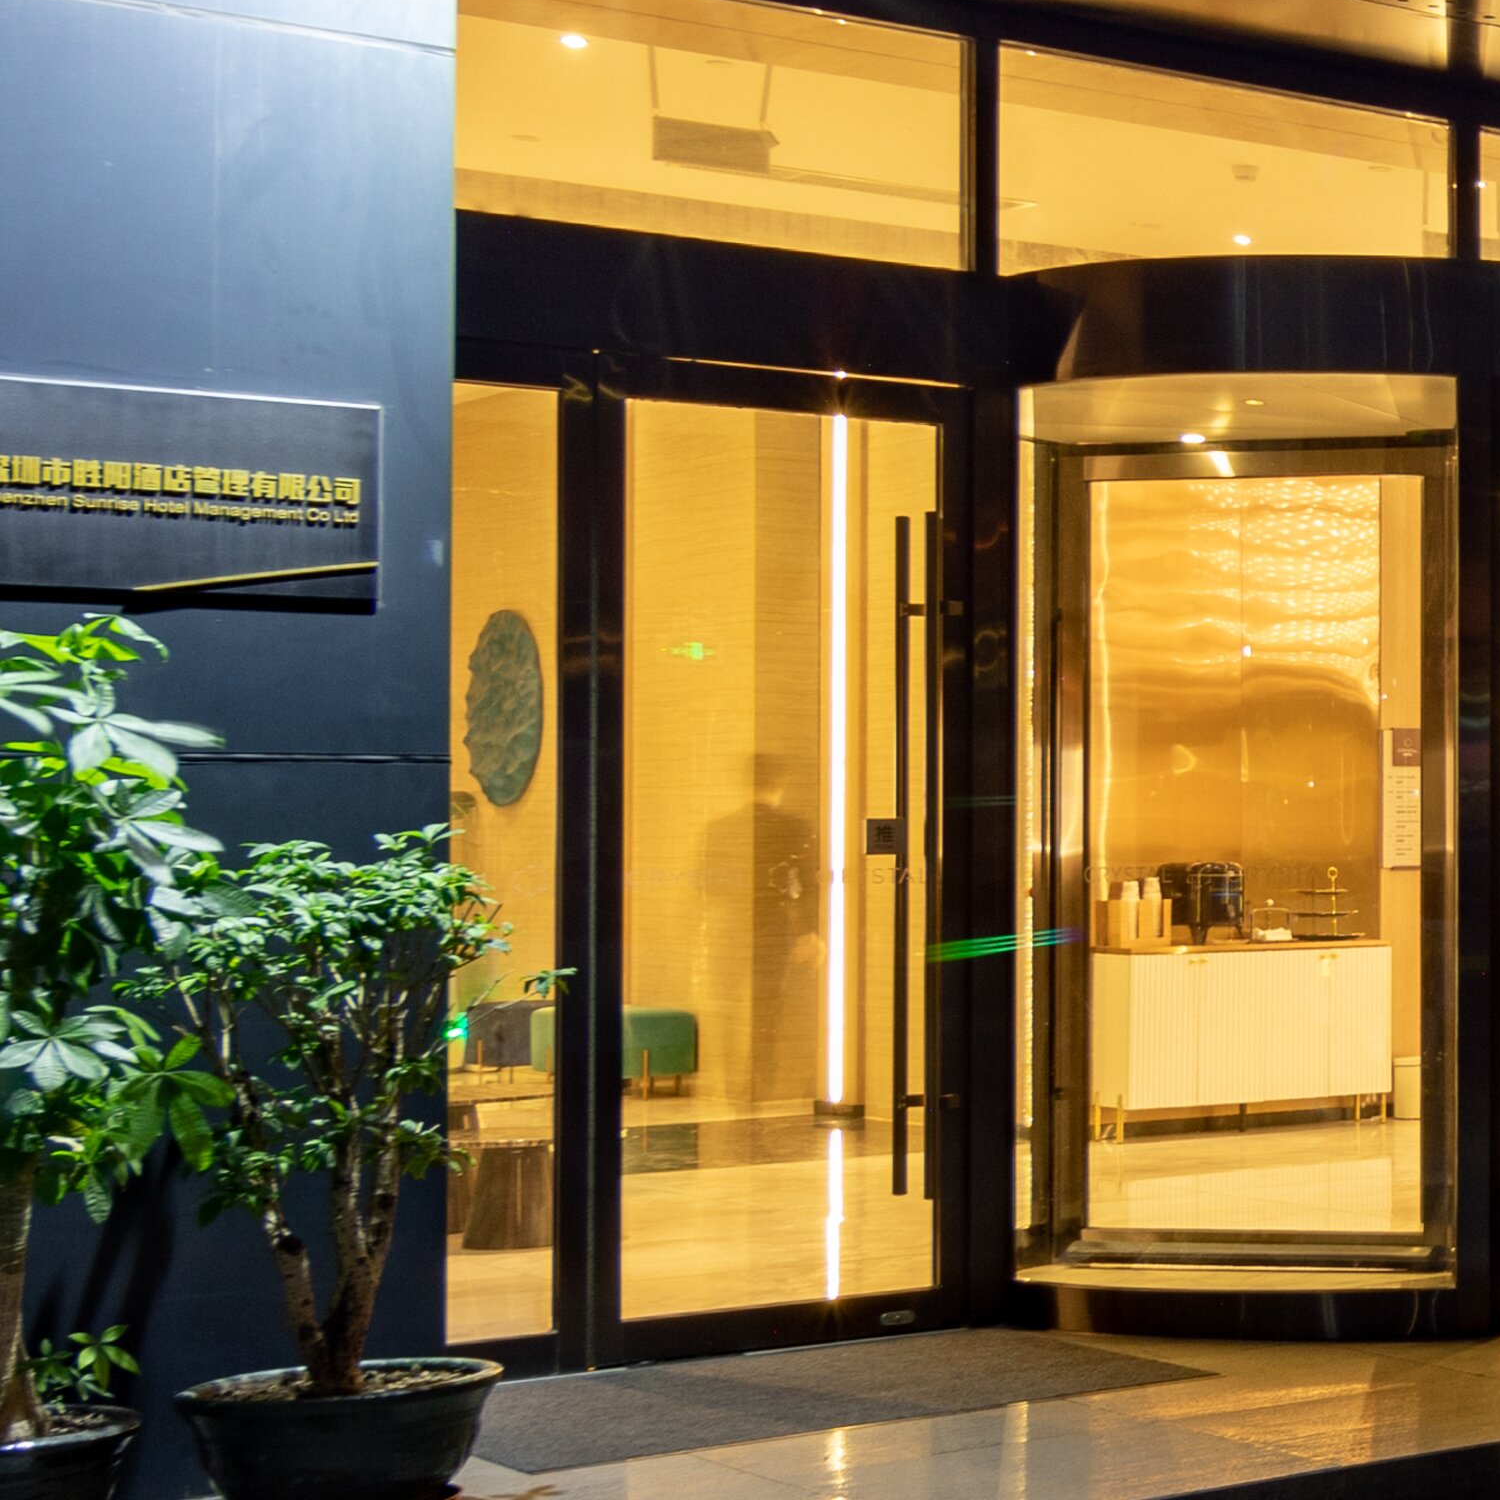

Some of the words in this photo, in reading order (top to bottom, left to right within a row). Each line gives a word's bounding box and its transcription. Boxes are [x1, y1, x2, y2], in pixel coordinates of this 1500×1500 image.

[71, 493, 141, 511] Sunrise
[144, 498, 189, 514] Hotel
[192, 501, 303, 521] Management
[305, 506, 331, 522] Co
[333, 508, 360, 524] Ltd
